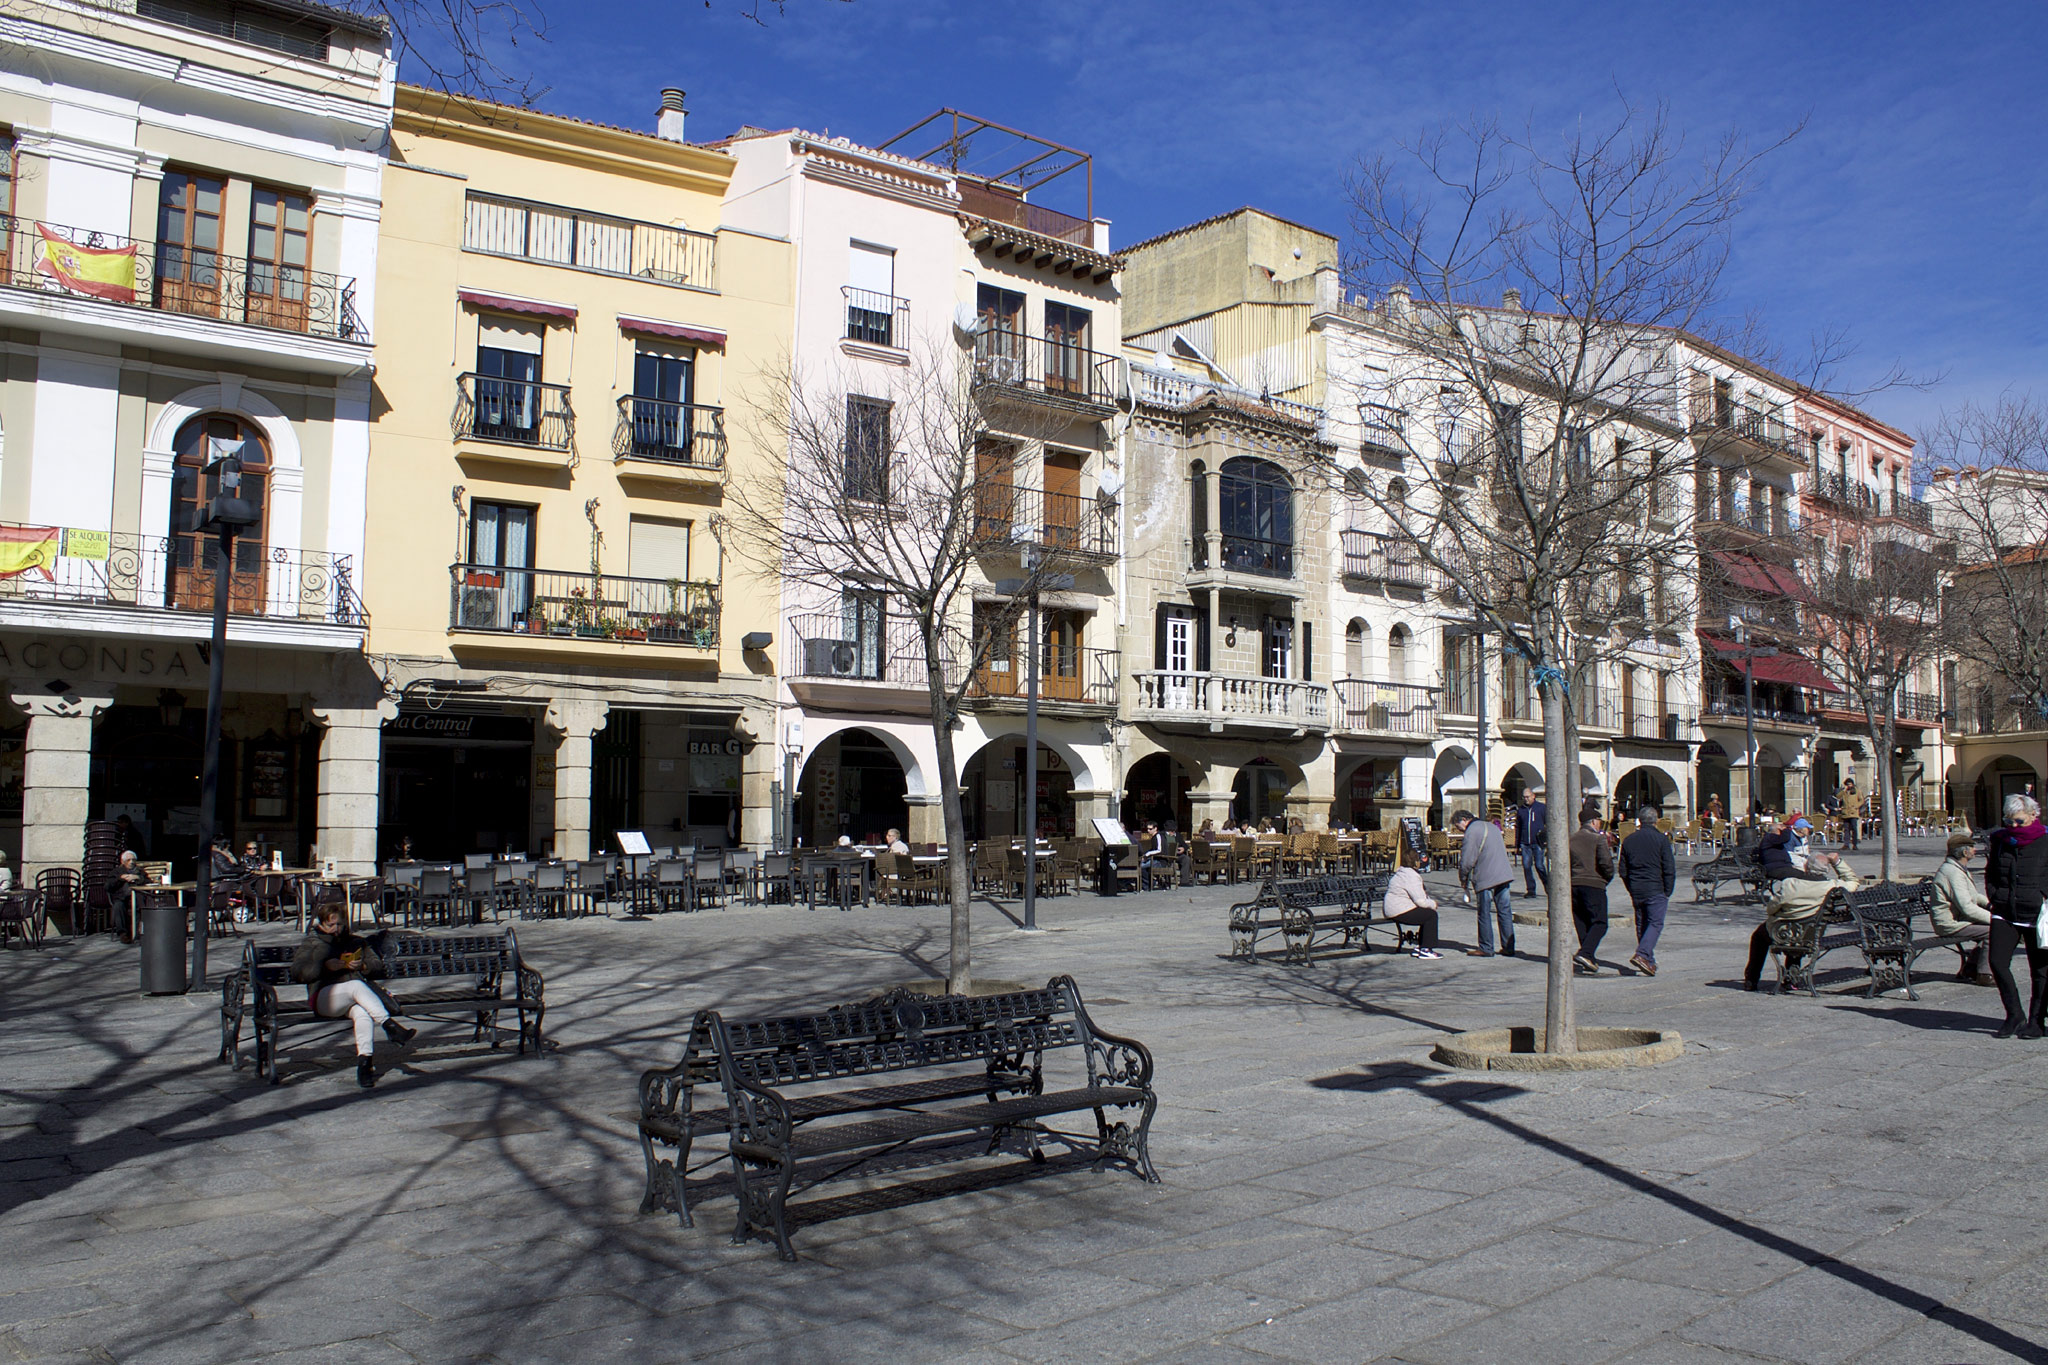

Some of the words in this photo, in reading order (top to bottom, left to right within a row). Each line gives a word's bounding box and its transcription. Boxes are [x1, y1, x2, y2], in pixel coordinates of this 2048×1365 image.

[70, 531, 77, 539] SE
[80, 532, 108, 542] ALQUILA
[412, 715, 474, 731] Central
[690, 742, 720, 754] BAR
